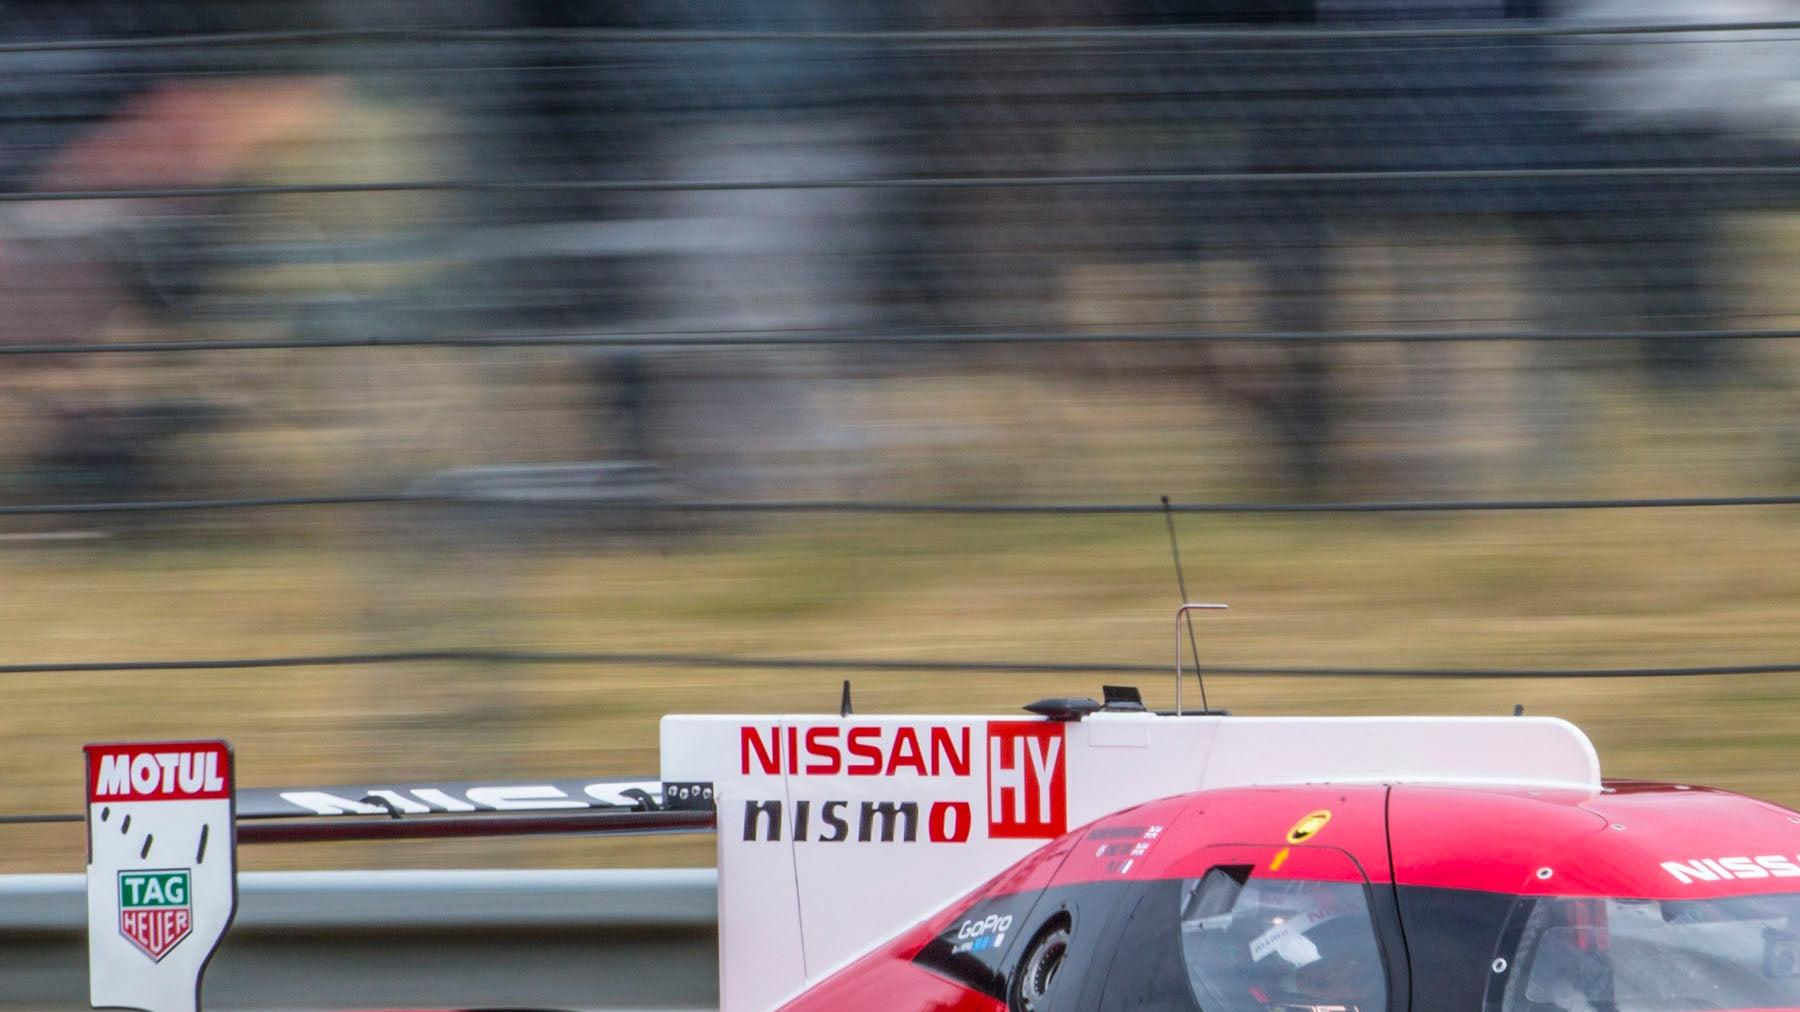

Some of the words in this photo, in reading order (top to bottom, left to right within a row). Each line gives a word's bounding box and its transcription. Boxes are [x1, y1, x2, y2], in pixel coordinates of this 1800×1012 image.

[741, 726, 970, 776] NISSAN
[96, 752, 224, 795] MOTUL
[988, 736, 1062, 824] HY
[743, 800, 971, 842] nismo
[125, 877, 184, 905] TAG
[124, 911, 187, 953] HEUER
[958, 914, 1013, 939] GoPro
